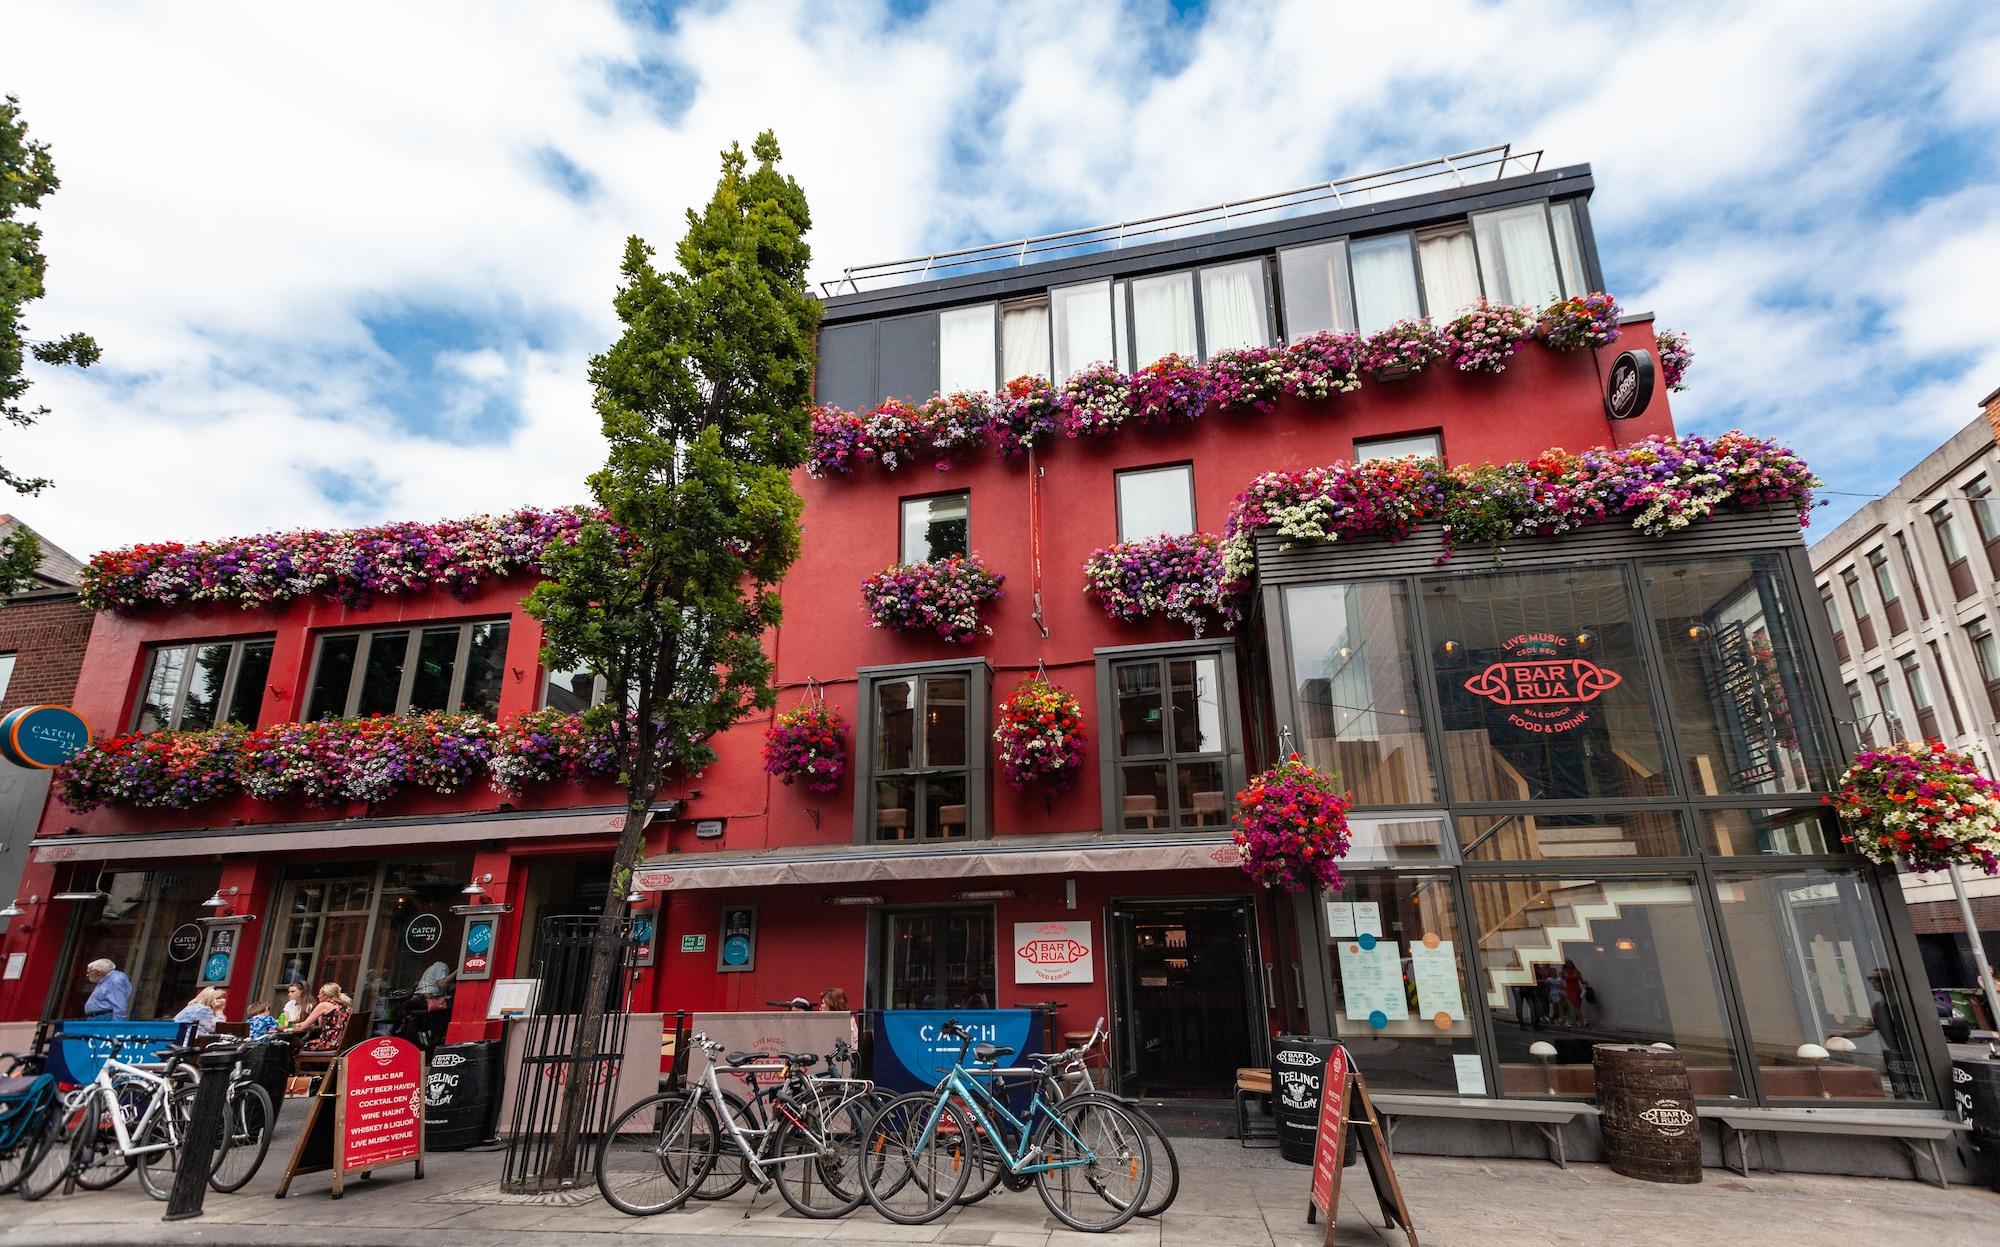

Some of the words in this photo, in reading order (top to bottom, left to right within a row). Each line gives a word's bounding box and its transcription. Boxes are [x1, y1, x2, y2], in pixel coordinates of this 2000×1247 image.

[1612, 370, 1636, 405] CARRIG
[1502, 634, 1526, 650] LIVE
[1528, 633, 1568, 647] MUSIC
[1516, 648, 1537, 657] CEOL
[1514, 666, 1567, 683] BAR
[1516, 682, 1570, 698] RUA
[1524, 708, 1537, 718] BIA
[1545, 706, 1571, 719] DEOCH
[1508, 714, 1543, 732] FOOD
[1544, 724, 1553, 733] &
[1554, 711, 1589, 733] DRINK
[32, 725, 76, 740] CATCH
[59, 740, 74, 750] 22
[411, 926, 436, 934] CATCH
[468, 928, 488, 946] CATCH
[174, 936, 197, 944] CATCH
[1041, 943, 1064, 952] BAR
[1041, 952, 1065, 960] RUA
[752, 1037, 766, 1047] LIVE
[766, 1037, 785, 1047] MUSIC
[364, 1073, 389, 1083] PUBLIC
[390, 1071, 404, 1079] BAR
[426, 1072, 460, 1087] TEELING
[1278, 1071, 1320, 1089] TEELING
[350, 1087, 375, 1096] CRAFT
[374, 1084, 393, 1093] BEER
[393, 1082, 416, 1090] HAVEN
[359, 1098, 393, 1108] COCKTAIL
[1282, 1094, 1318, 1109] DISTILLERY
[361, 1111, 380, 1120] WINE
[382, 1107, 405, 1117] HAUNT
[351, 1123, 383, 1135] WHISKEY
[383, 1122, 389, 1130] &
[390, 1118, 414, 1129] LIQUOR
[351, 1139, 367, 1149] LIVE
[367, 1135, 391, 1145] MUSIC
[390, 1130, 413, 1141] VENUE
